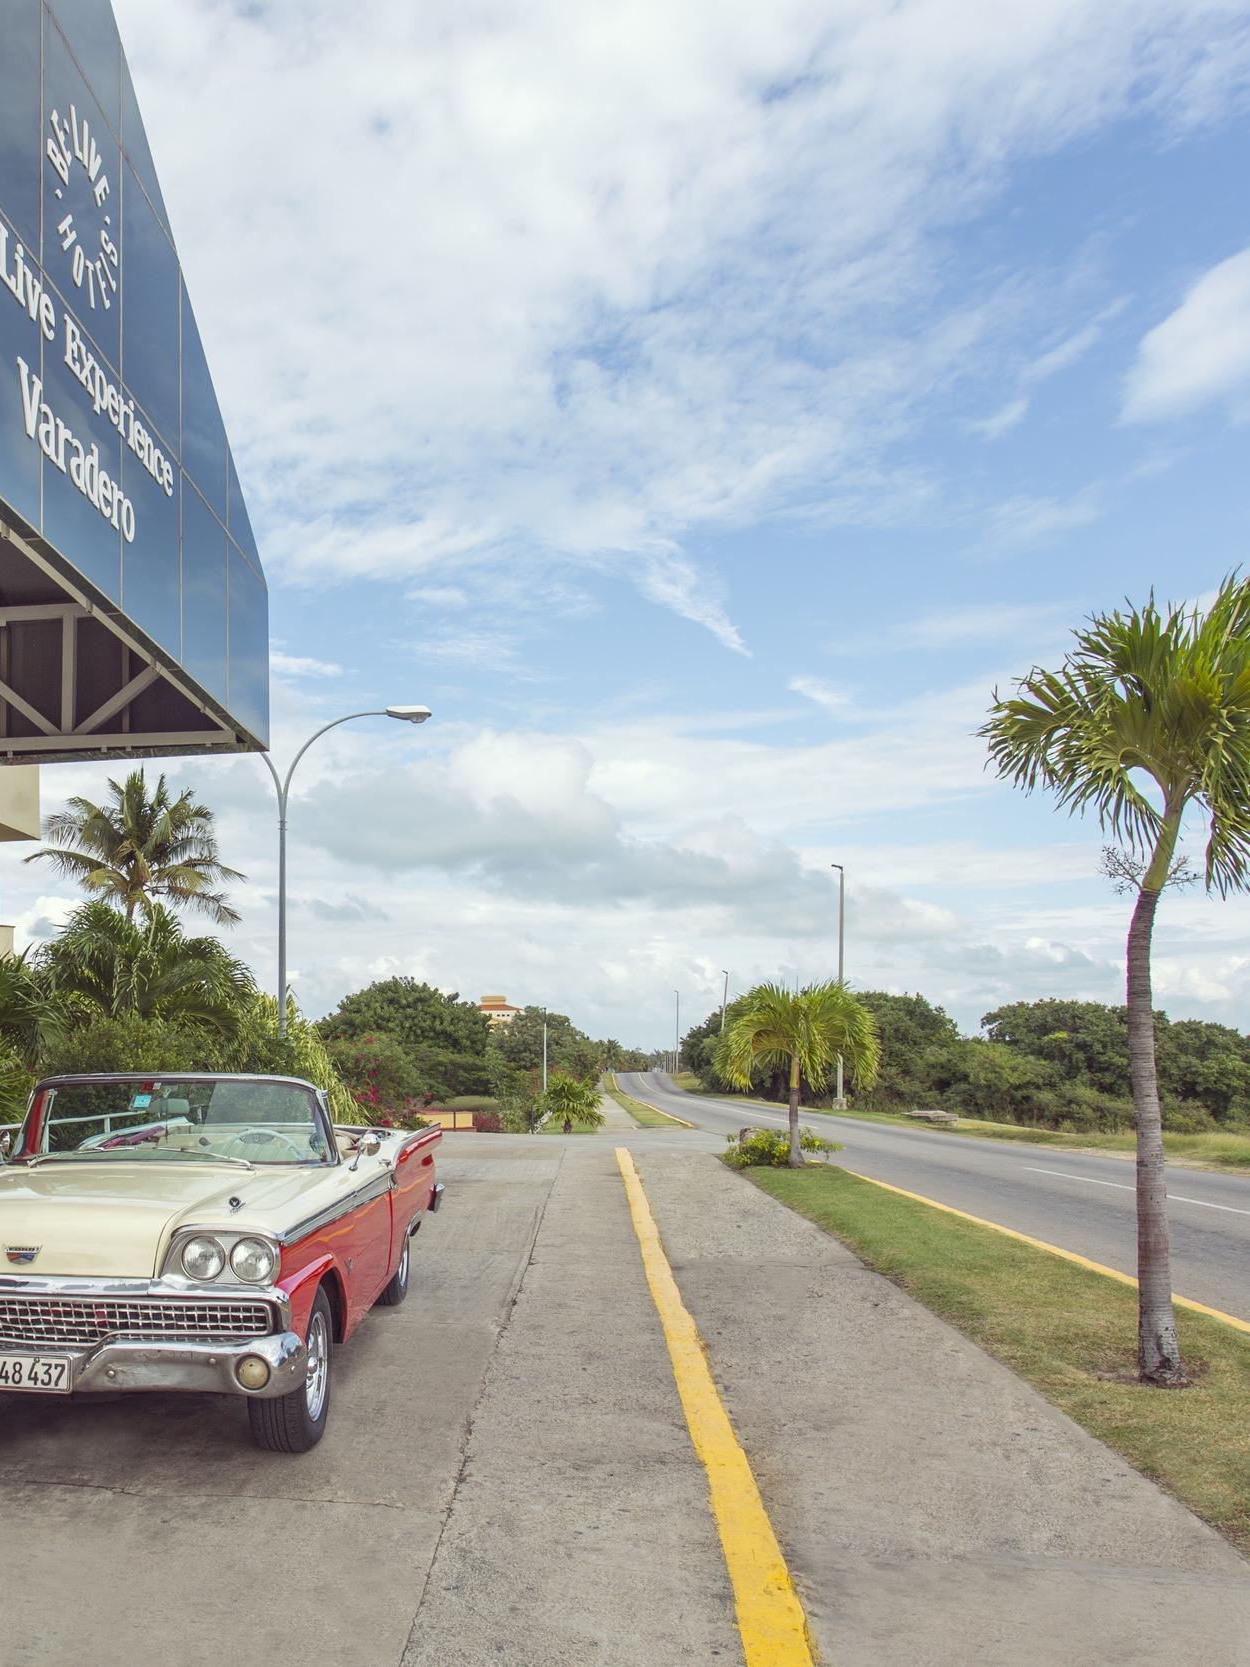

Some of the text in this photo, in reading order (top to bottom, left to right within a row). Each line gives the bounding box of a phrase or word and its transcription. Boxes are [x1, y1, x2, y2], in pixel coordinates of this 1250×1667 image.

[57, 214, 118, 310] HOTELS
[17, 356, 136, 543] Varadero
[63, 314, 174, 497] Experience
